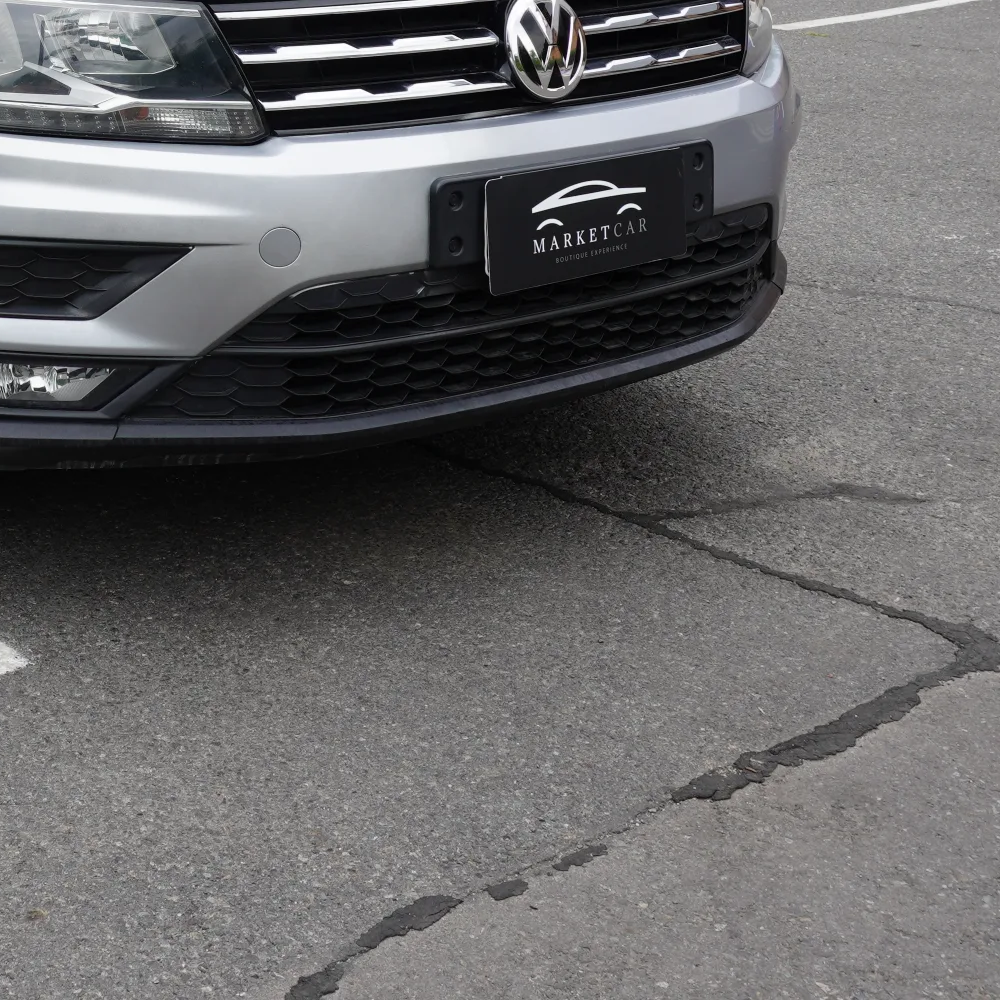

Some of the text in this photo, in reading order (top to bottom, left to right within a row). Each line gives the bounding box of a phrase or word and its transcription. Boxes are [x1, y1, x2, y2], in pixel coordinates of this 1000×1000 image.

[532, 217, 648, 255] MARKETCAR
[555, 243, 628, 264] BOUTIQUE EXPERIENCE
